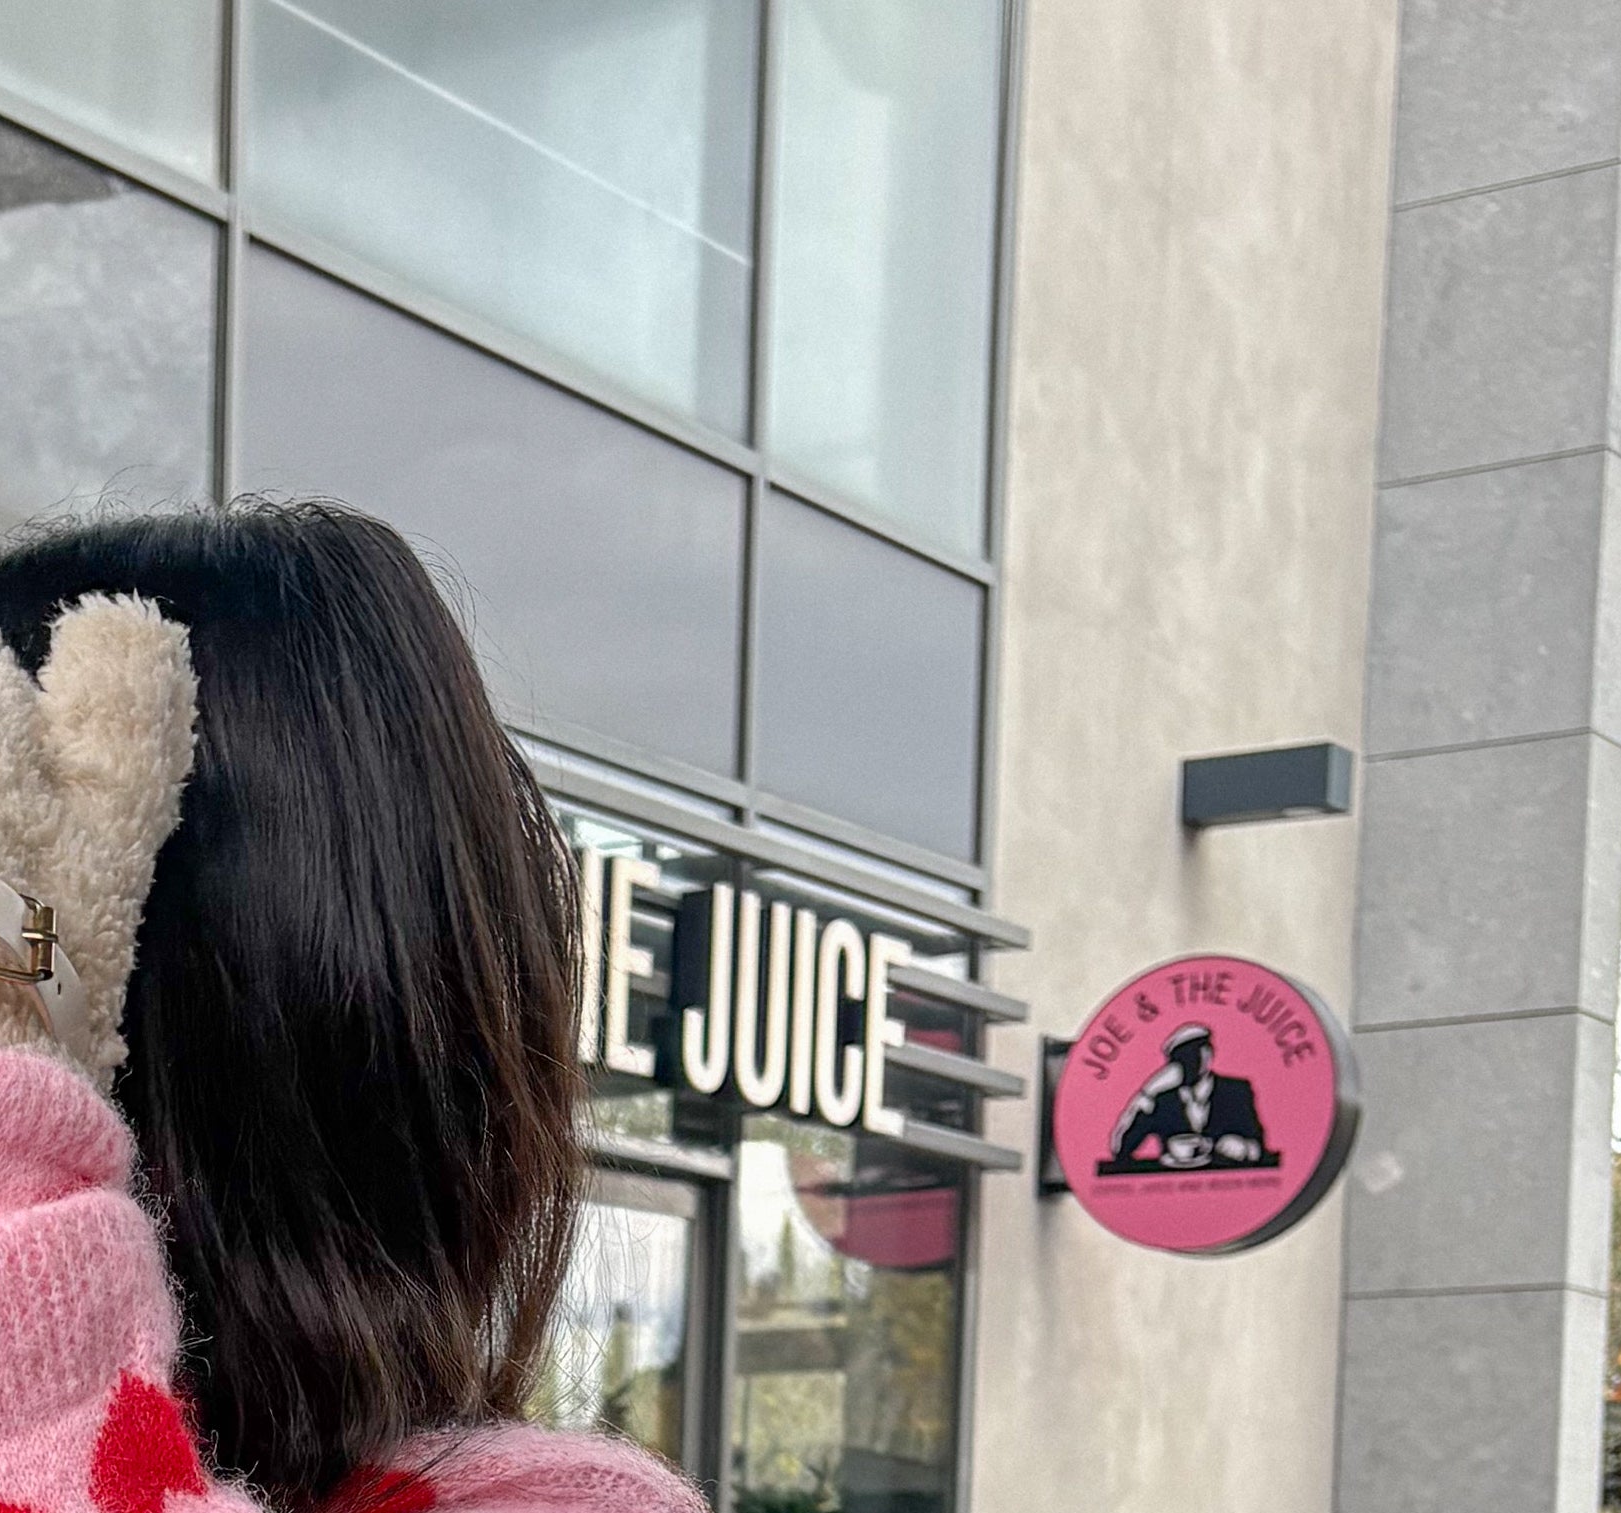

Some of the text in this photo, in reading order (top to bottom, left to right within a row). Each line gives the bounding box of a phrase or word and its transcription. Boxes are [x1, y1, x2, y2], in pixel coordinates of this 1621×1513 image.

[682, 881, 912, 1137] JUICE
[1081, 971, 1317, 1081] JOE & THE JUICE
